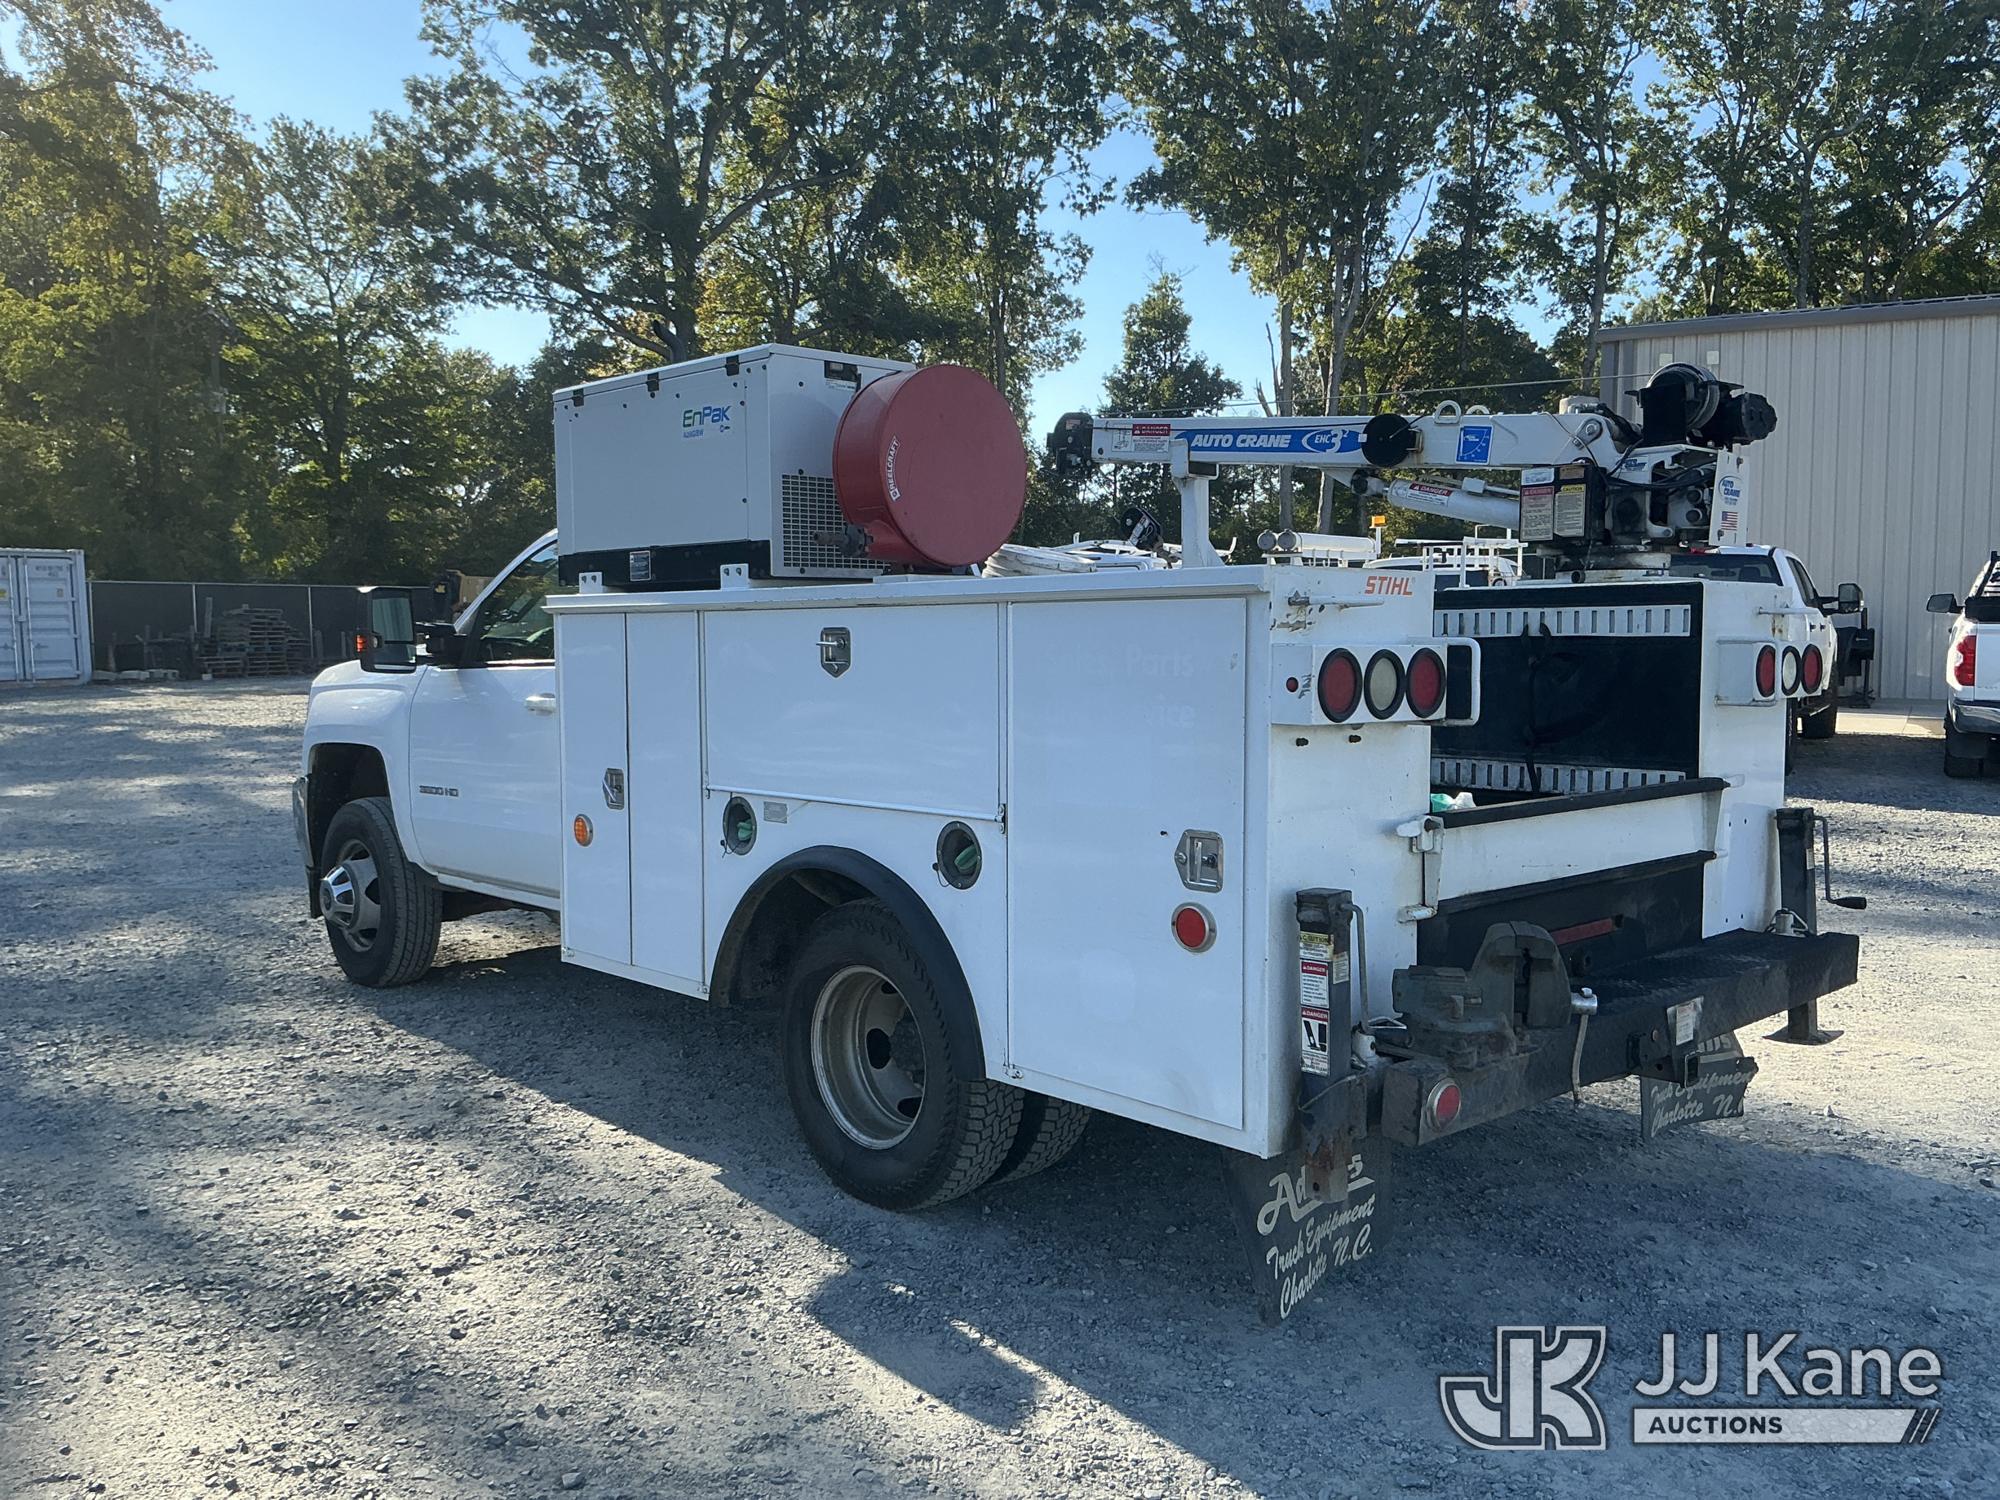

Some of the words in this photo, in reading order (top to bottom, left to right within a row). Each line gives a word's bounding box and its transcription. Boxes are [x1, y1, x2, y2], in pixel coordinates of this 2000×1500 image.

[683, 405, 731, 428] EnPak
[1191, 434, 1233, 448] AUTO
[1236, 434, 1292, 448] CRANE
[1314, 431, 1331, 444] EHC
[1420, 485, 1449, 496] DANGER
[1306, 1010, 1328, 1019] DANGER
[1266, 1230, 1304, 1280] Truck
[1305, 1193, 1376, 1254] Equipment
[1280, 1252, 1327, 1319] Charlotte
